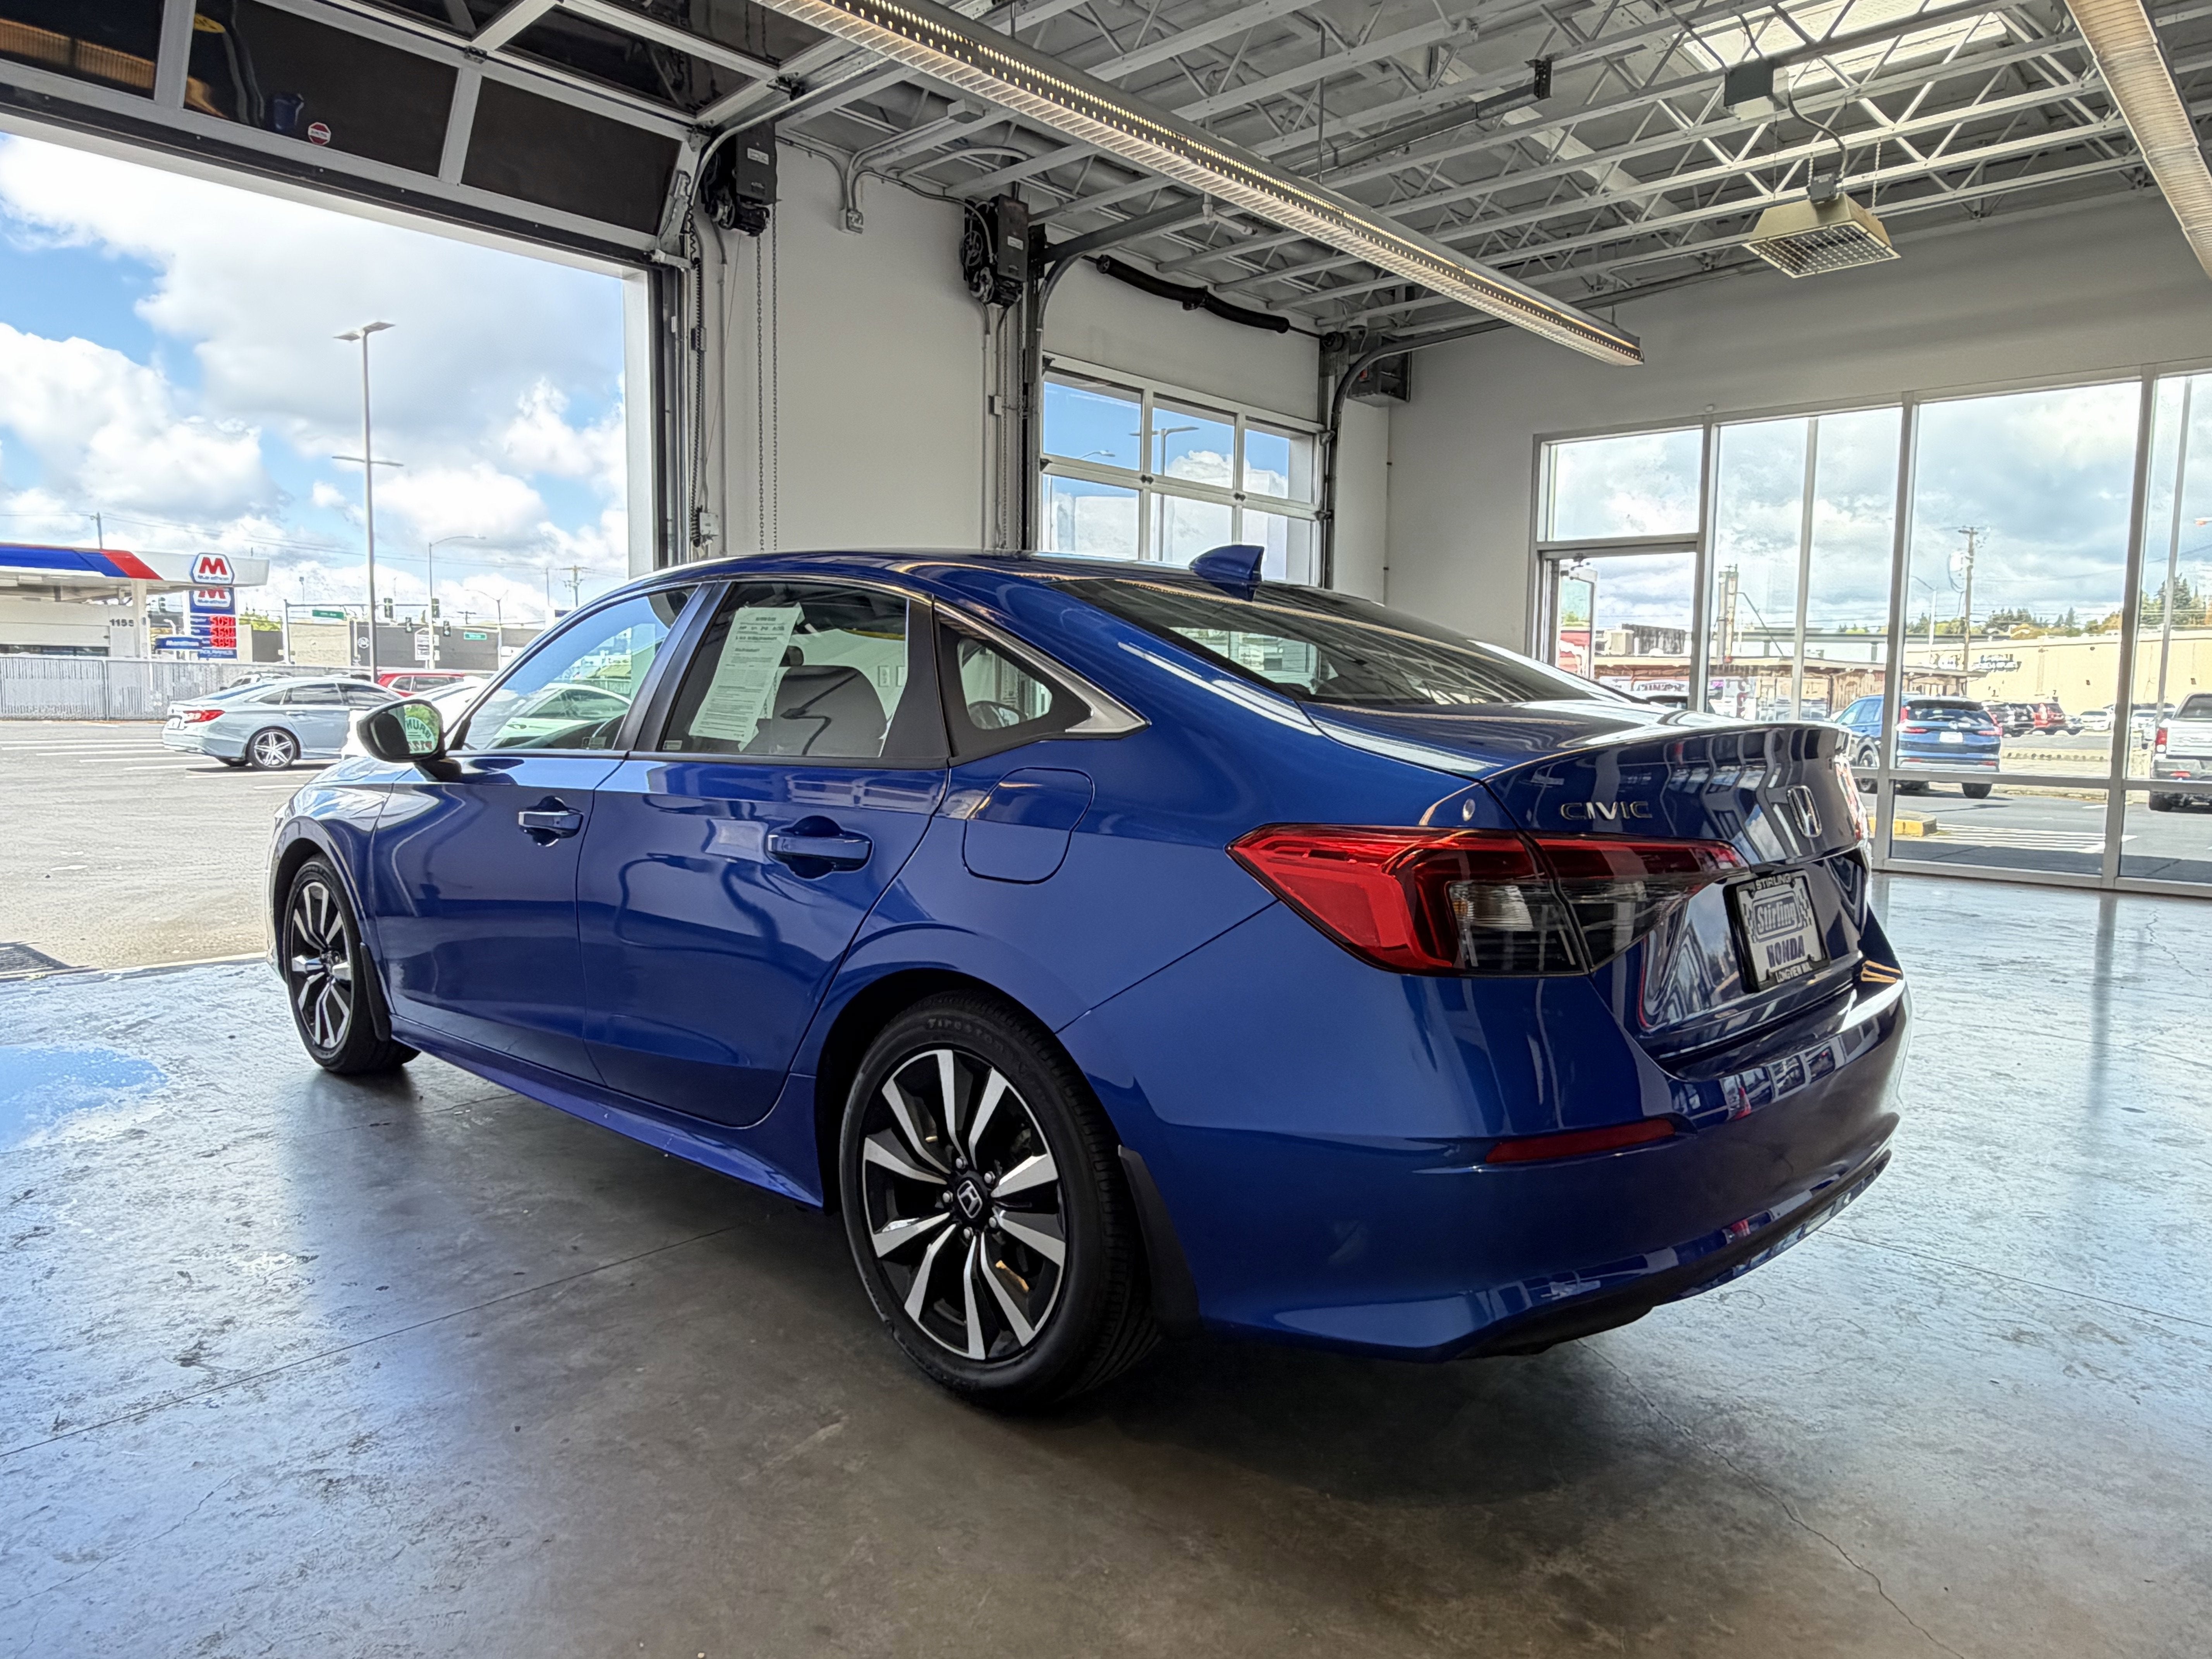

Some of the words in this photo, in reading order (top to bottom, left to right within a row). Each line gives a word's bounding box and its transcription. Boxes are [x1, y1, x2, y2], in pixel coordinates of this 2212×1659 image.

[1560, 801, 1653, 820] CIVIC
[1755, 873, 1791, 890] STIRLING
[1757, 901, 1796, 933] Stirling
[1766, 935, 1805, 968] HONDA
[928, 1018, 1013, 1060] Fireston
